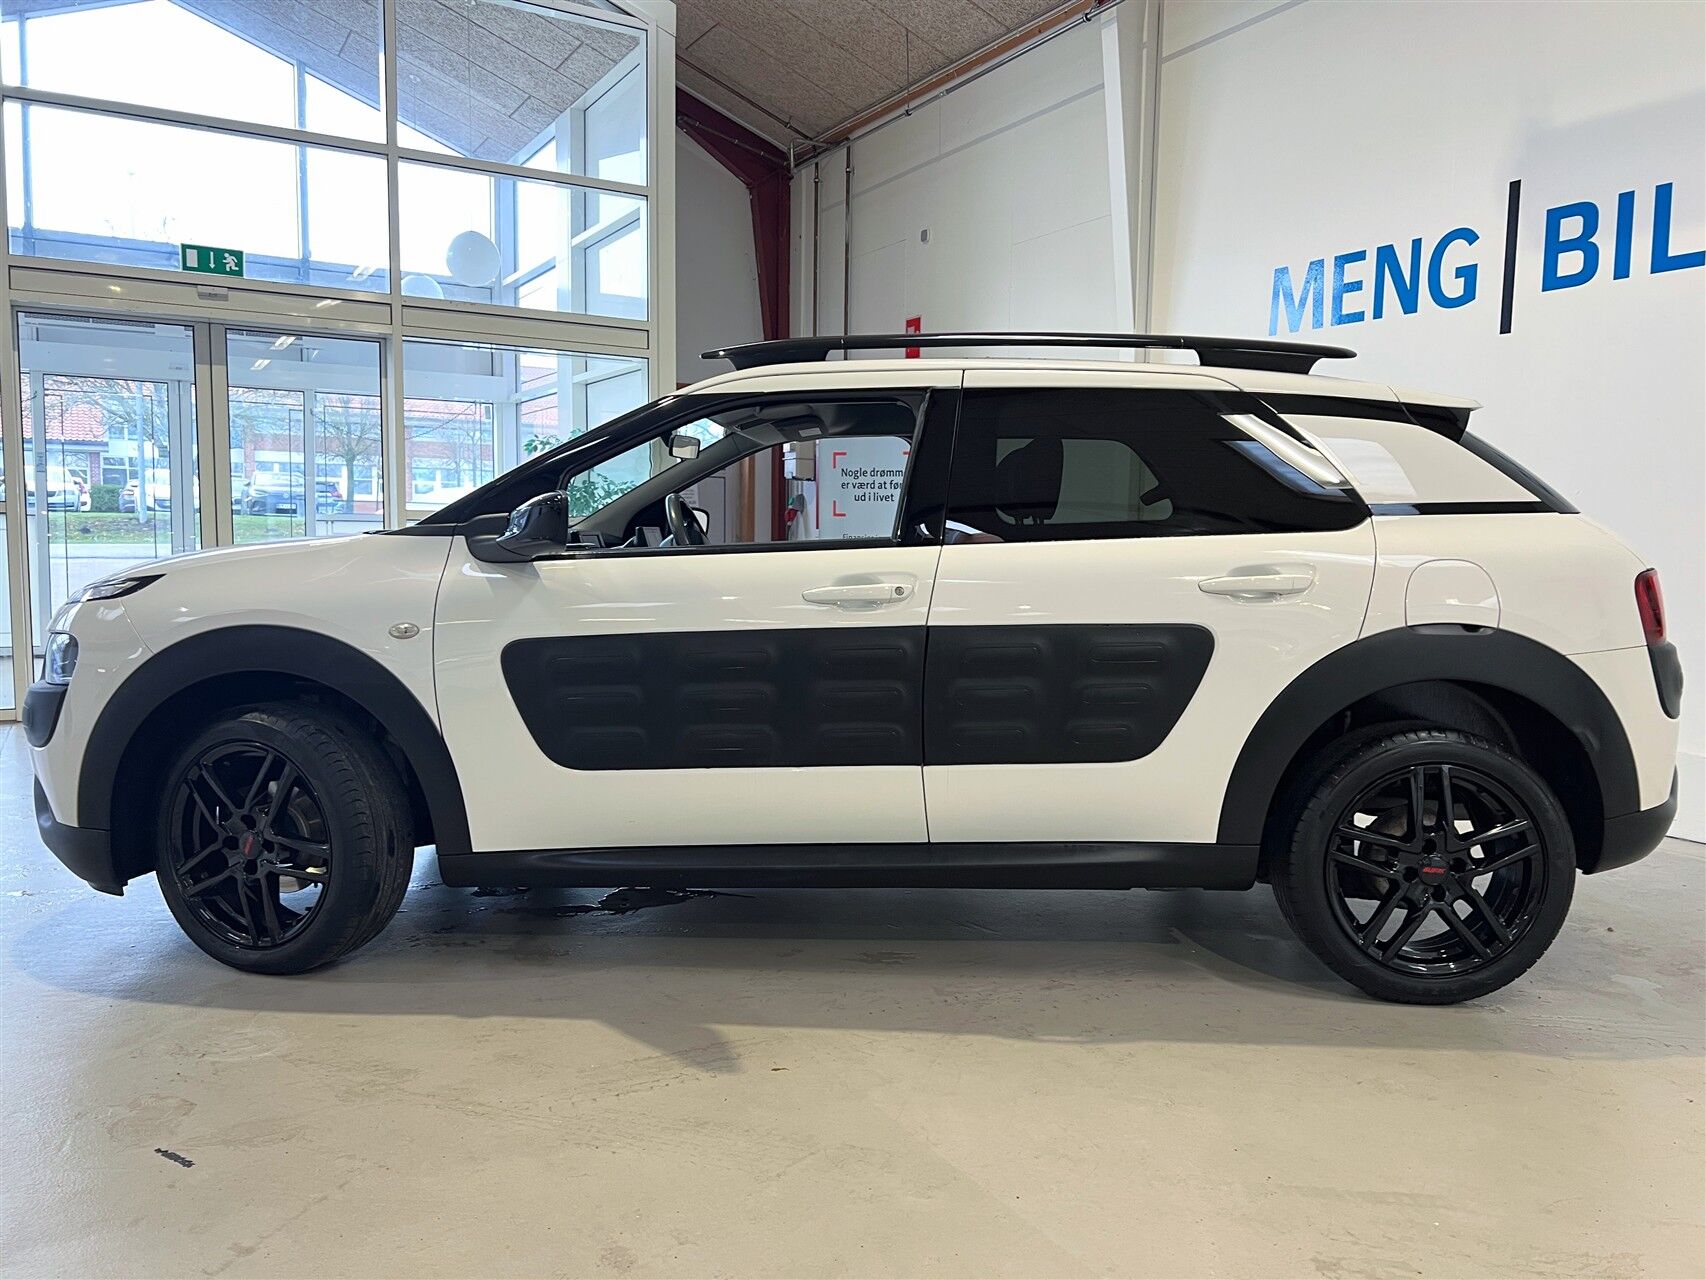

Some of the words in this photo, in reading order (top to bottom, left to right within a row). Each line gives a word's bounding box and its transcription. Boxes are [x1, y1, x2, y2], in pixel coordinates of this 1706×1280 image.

[1268, 227, 1480, 337] MENG
[1541, 182, 1706, 292] BIL
[841, 467, 868, 480] Nogle
[841, 481, 852, 489] er
[852, 480, 876, 489] værd
[877, 481, 887, 489] at
[854, 492, 866, 501] ud
[868, 492, 871, 501] i
[873, 492, 895, 501] livet
